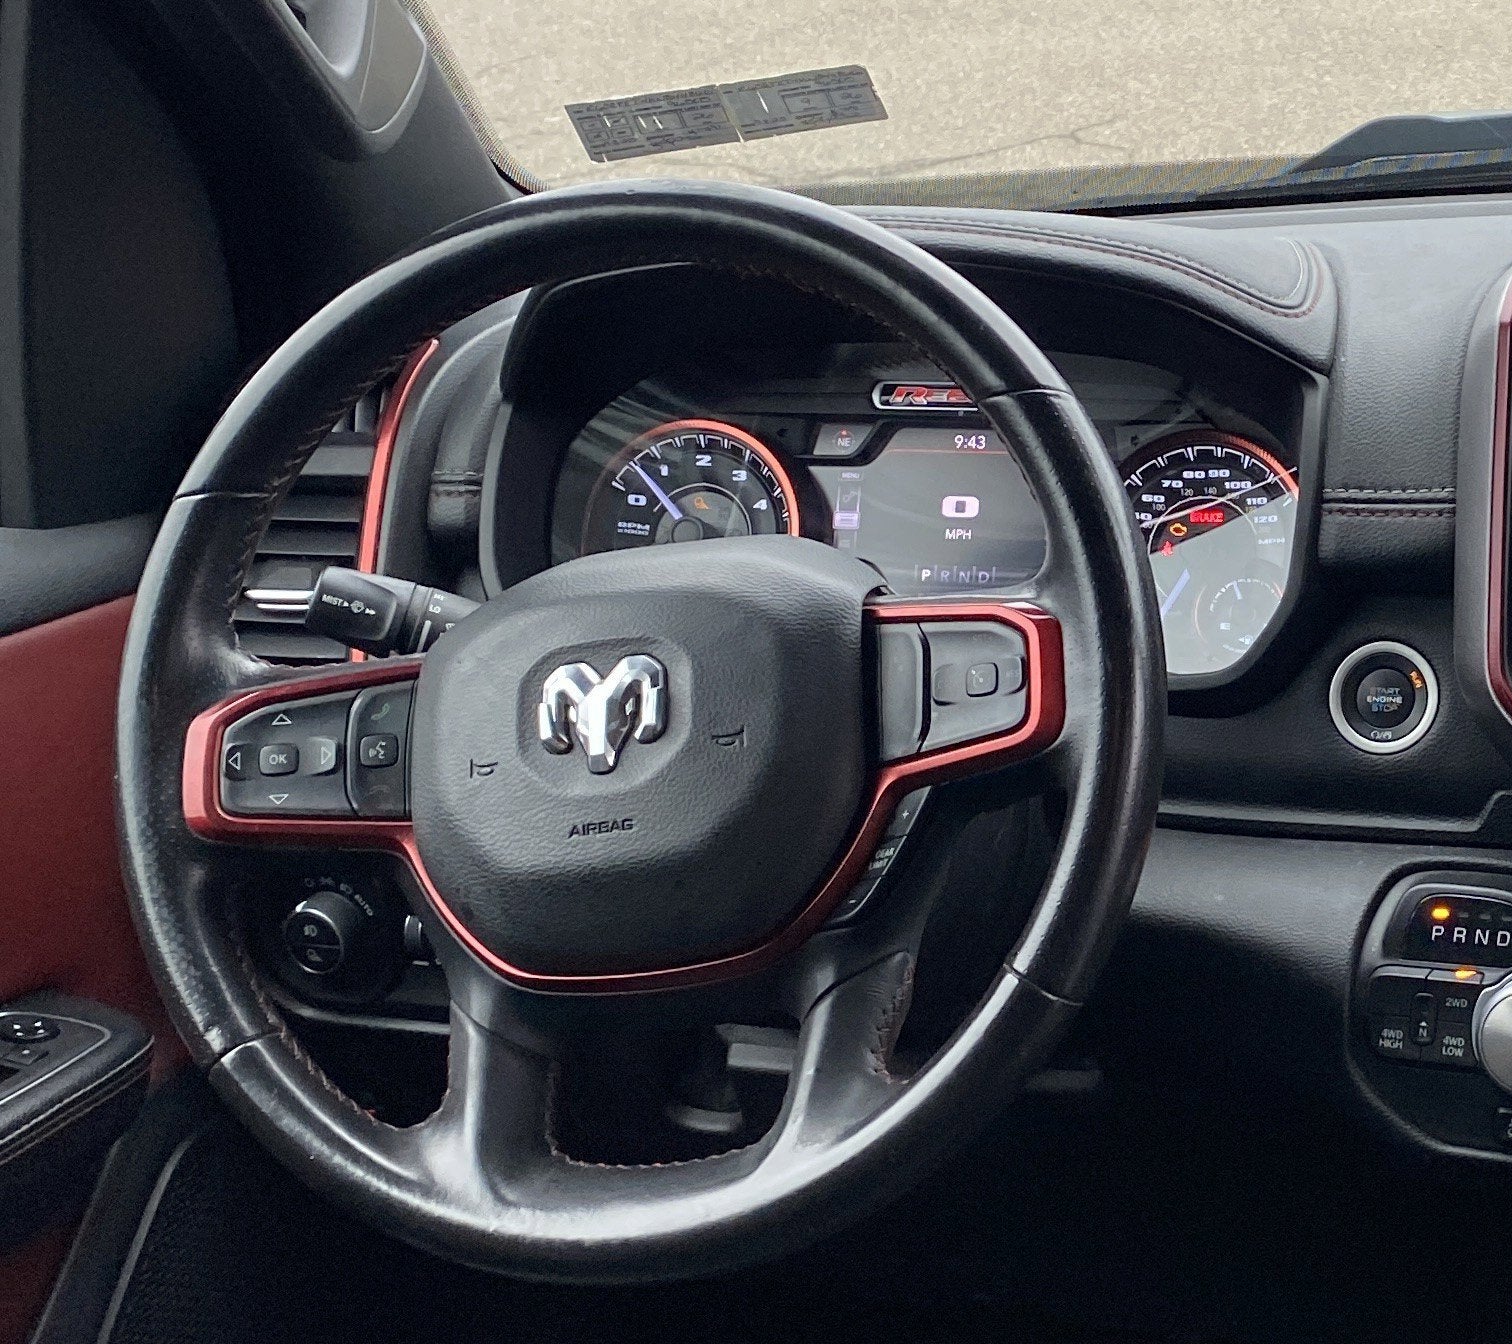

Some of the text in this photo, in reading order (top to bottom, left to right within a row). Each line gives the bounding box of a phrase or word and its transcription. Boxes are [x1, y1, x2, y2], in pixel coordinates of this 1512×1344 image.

[837, 437, 851, 447] NE
[955, 435, 986, 450] 9:43
[695, 454, 712, 467] 2
[732, 470, 747, 482] 3
[1161, 479, 1184, 488] 70
[1224, 480, 1252, 490] 100
[627, 494, 647, 506] 0
[752, 499, 768, 511] 4
[942, 496, 979, 518] 0
[1253, 515, 1278, 524] 120
[945, 529, 972, 540] MPH
[1258, 537, 1286, 545] MPH
[921, 569, 931, 581] P
[322, 594, 343, 606] MIST
[429, 605, 441, 614] LO
[1370, 687, 1400, 695] START
[1366, 695, 1403, 704] ENGINE
[1371, 704, 1399, 712] STOP
[268, 753, 287, 765] OK
[568, 818, 634, 838] AIRBAG
[354, 894, 374, 916] AUTO
[1431, 926, 1511, 947] P R N D
[1445, 998, 1468, 1008] 2WD
[1381, 1028, 1403, 1040] 4WD
[1418, 1028, 1427, 1037] N
[1378, 1039, 1403, 1049] HIGH
[1443, 1036, 1465, 1047] 4WD
[1442, 1046, 1464, 1057] LOW
